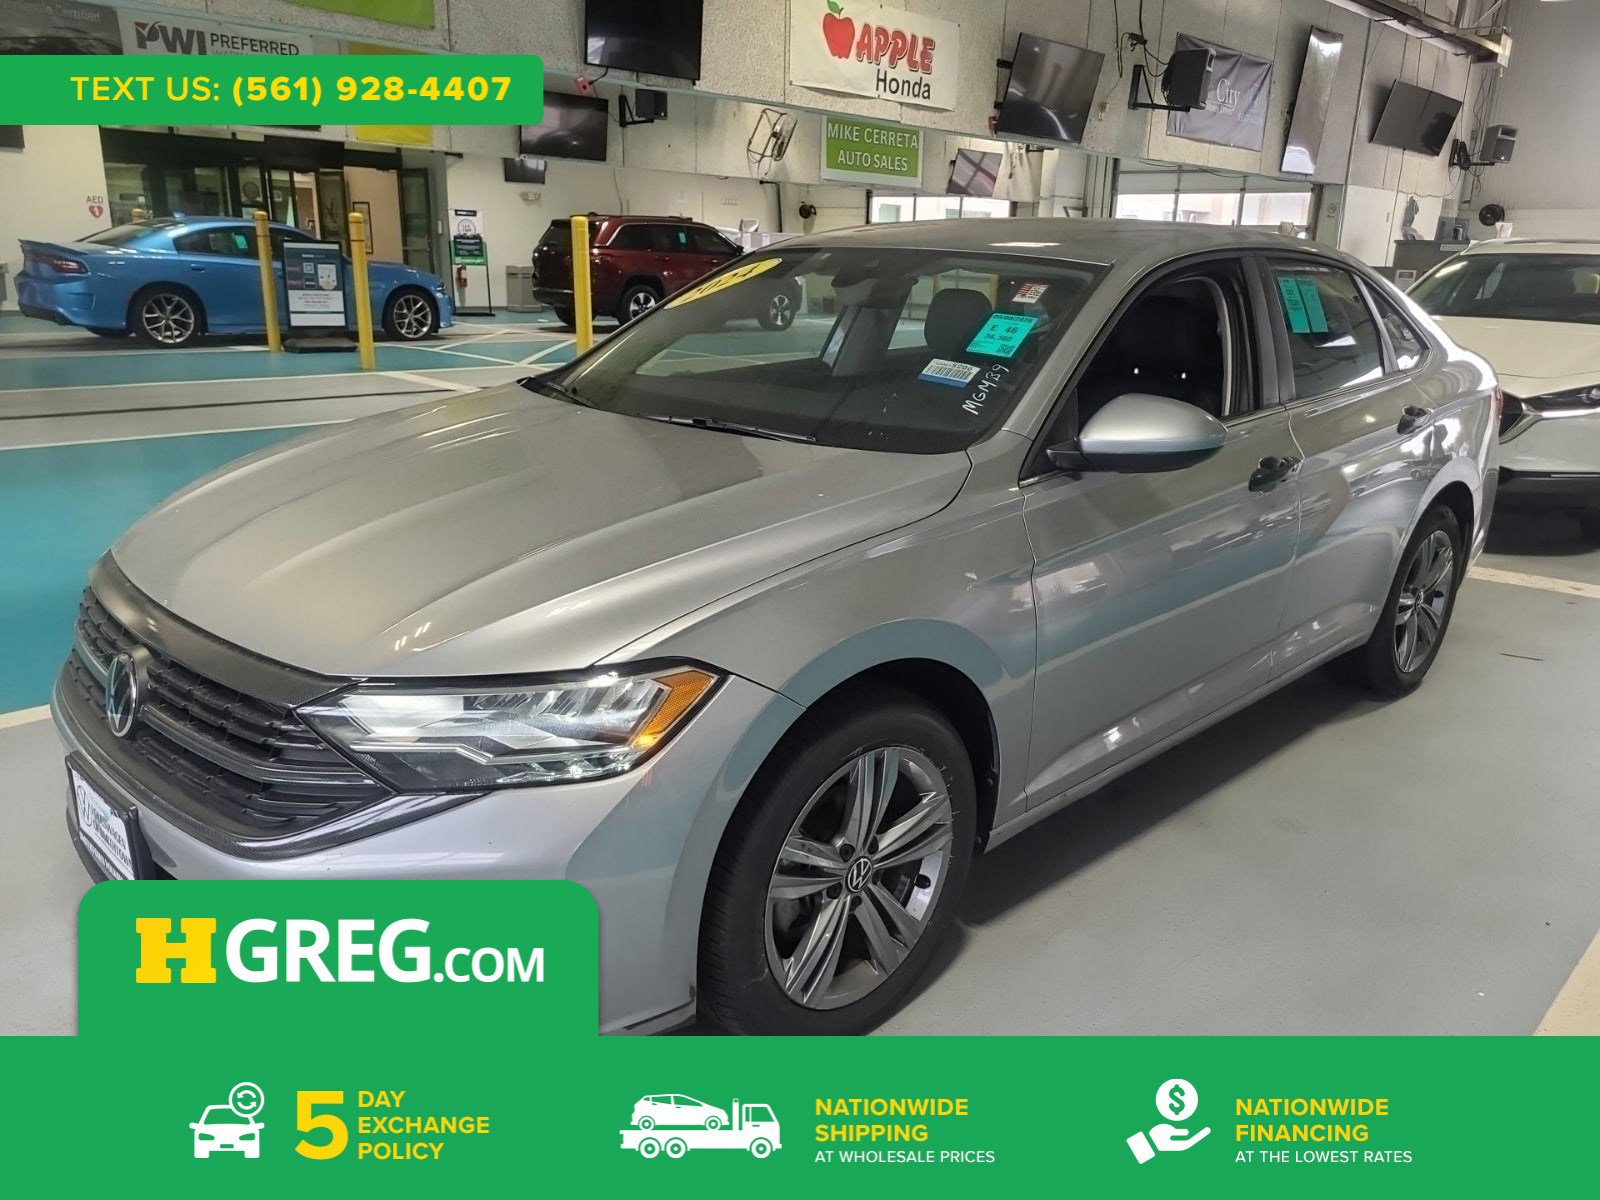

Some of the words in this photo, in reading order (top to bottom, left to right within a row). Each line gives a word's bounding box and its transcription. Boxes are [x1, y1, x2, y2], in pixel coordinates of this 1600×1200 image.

[210, 33, 300, 56] PREFERRED
[856, 23, 935, 75] APPLE
[876, 69, 931, 99] Honda
[827, 122, 860, 141] MIKE
[864, 128, 918, 149] CERRETA
[838, 149, 871, 167] AUTO
[873, 154, 908, 171] SALES
[86, 195, 103, 204] AED
[990, 324, 999, 332] E
[1005, 326, 1019, 334] 46
